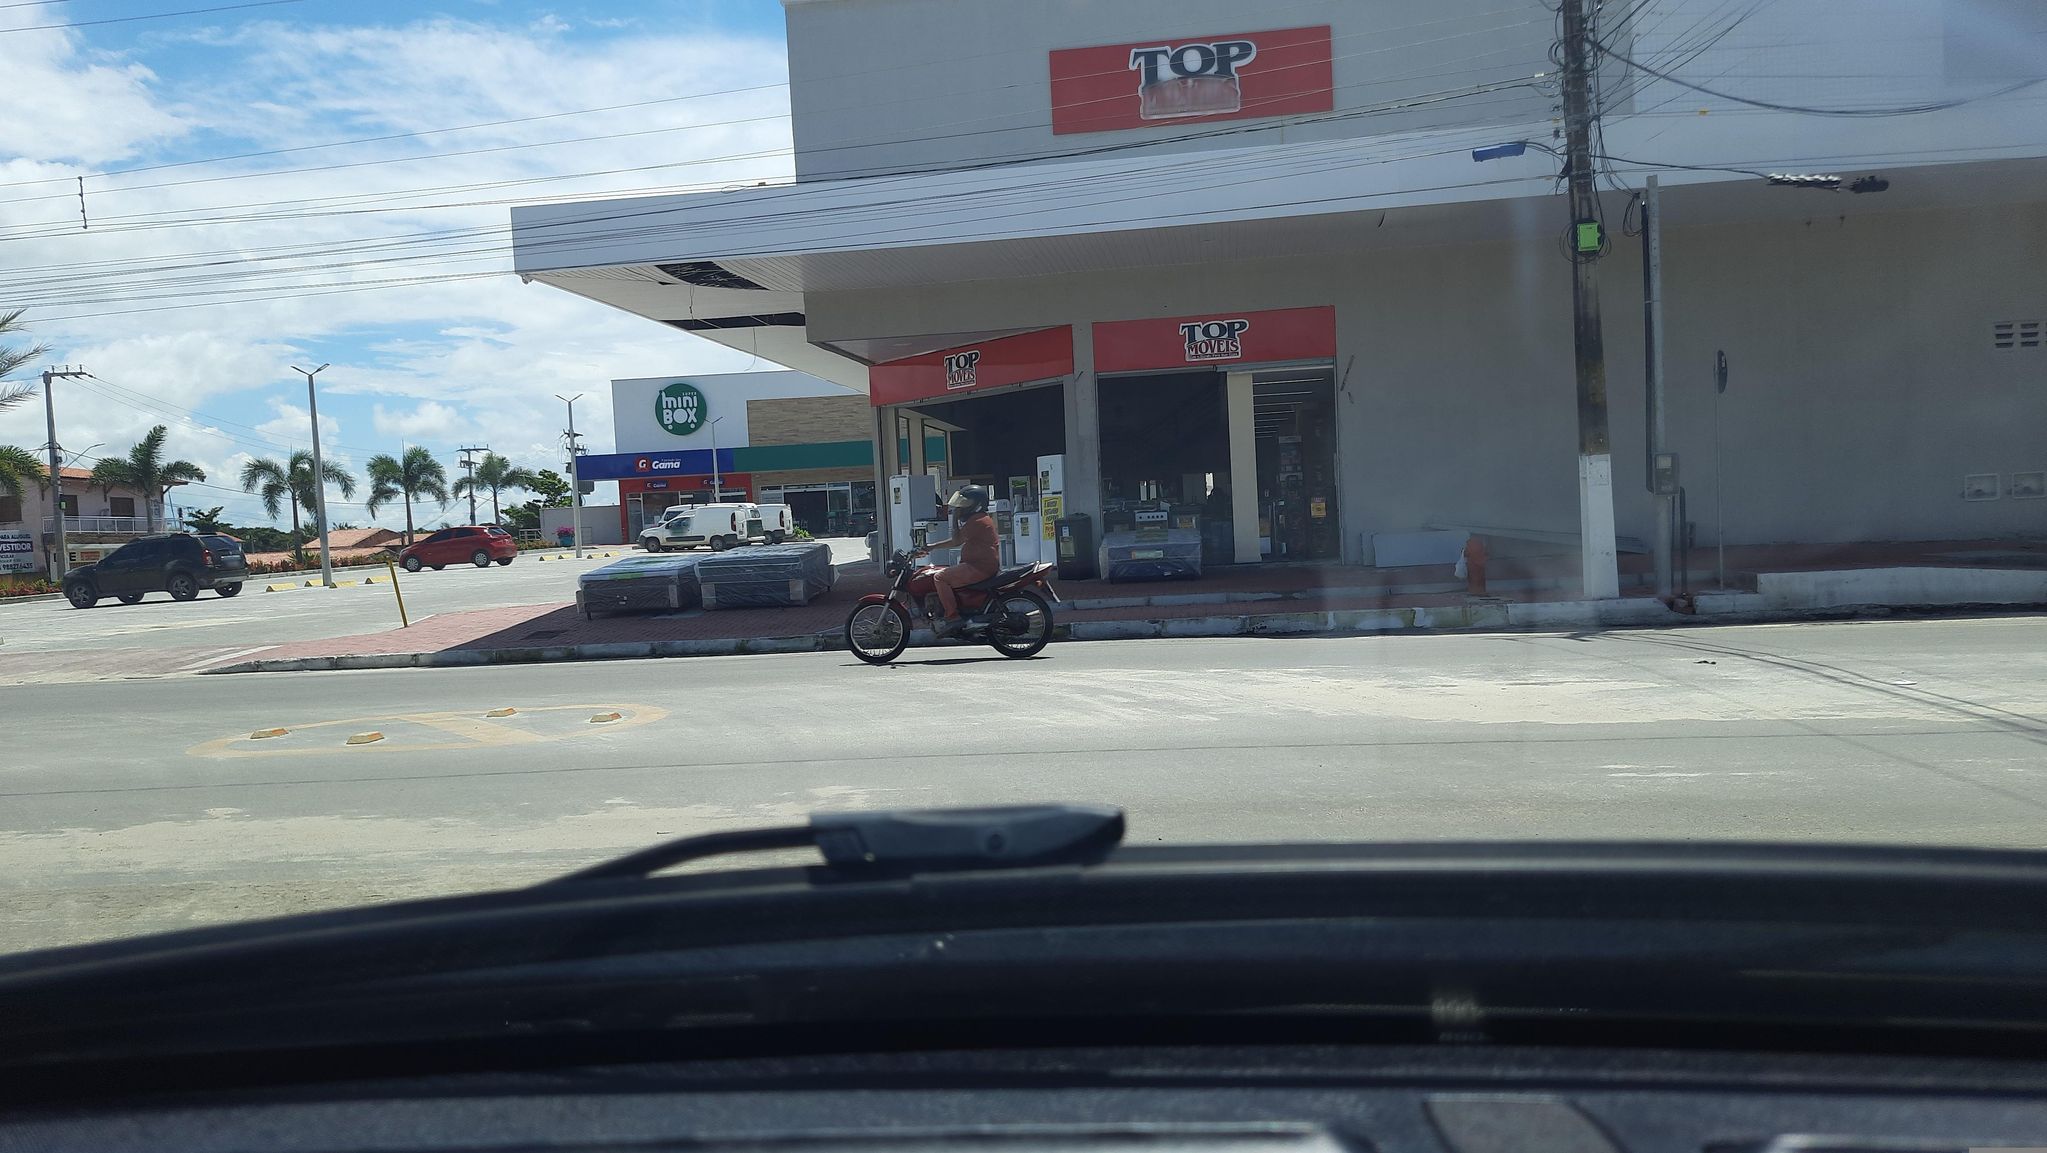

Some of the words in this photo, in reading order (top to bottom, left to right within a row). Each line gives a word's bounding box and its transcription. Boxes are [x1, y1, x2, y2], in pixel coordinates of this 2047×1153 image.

[1131, 41, 1254, 86] TOP
[1180, 320, 1248, 344] TOP
[944, 351, 980, 373] TOP
[662, 407, 698, 425] BOX
[652, 460, 681, 470] Gama
